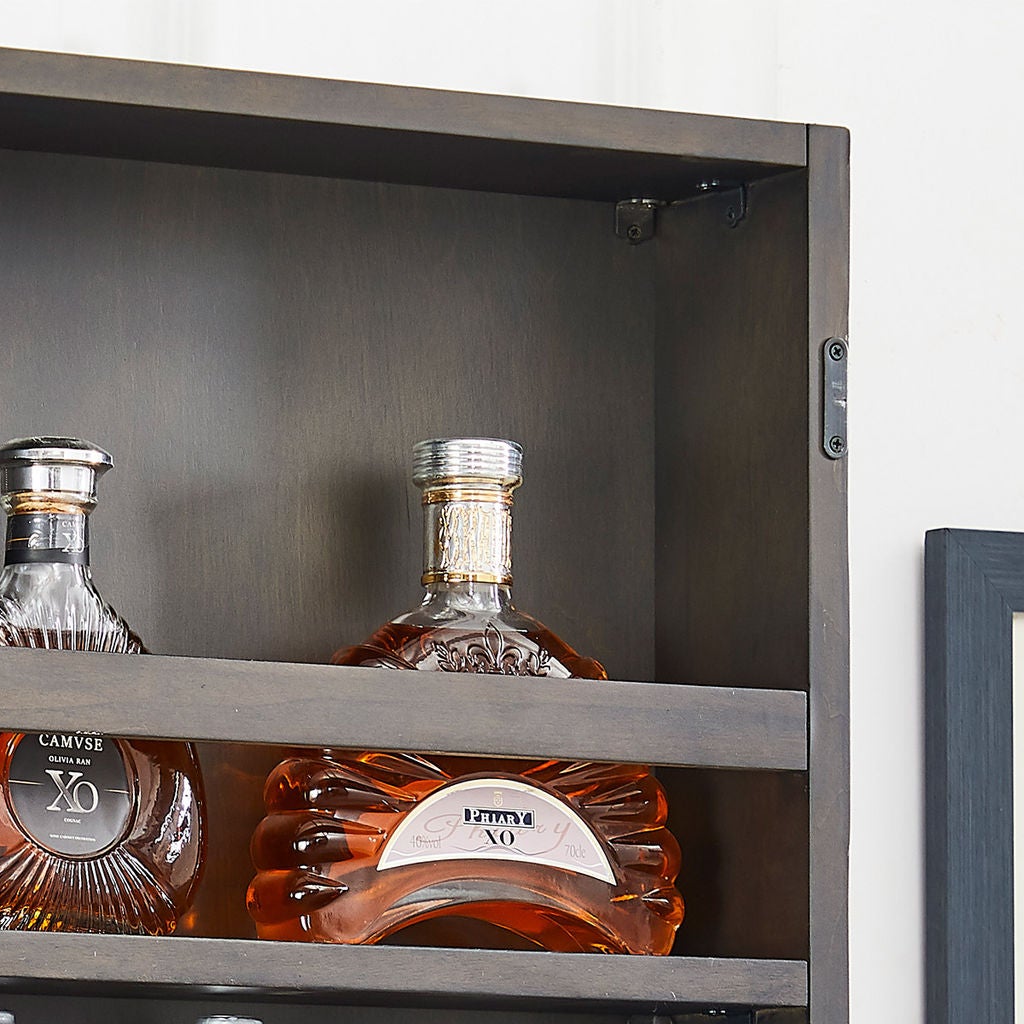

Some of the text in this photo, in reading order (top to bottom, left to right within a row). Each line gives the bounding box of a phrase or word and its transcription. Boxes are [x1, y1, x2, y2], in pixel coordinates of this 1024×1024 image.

[39, 734, 103, 751] CAMVSE
[48, 755, 91, 766] OLIVIA RAN
[45, 769, 99, 813] XO
[484, 829, 515, 846] XO
